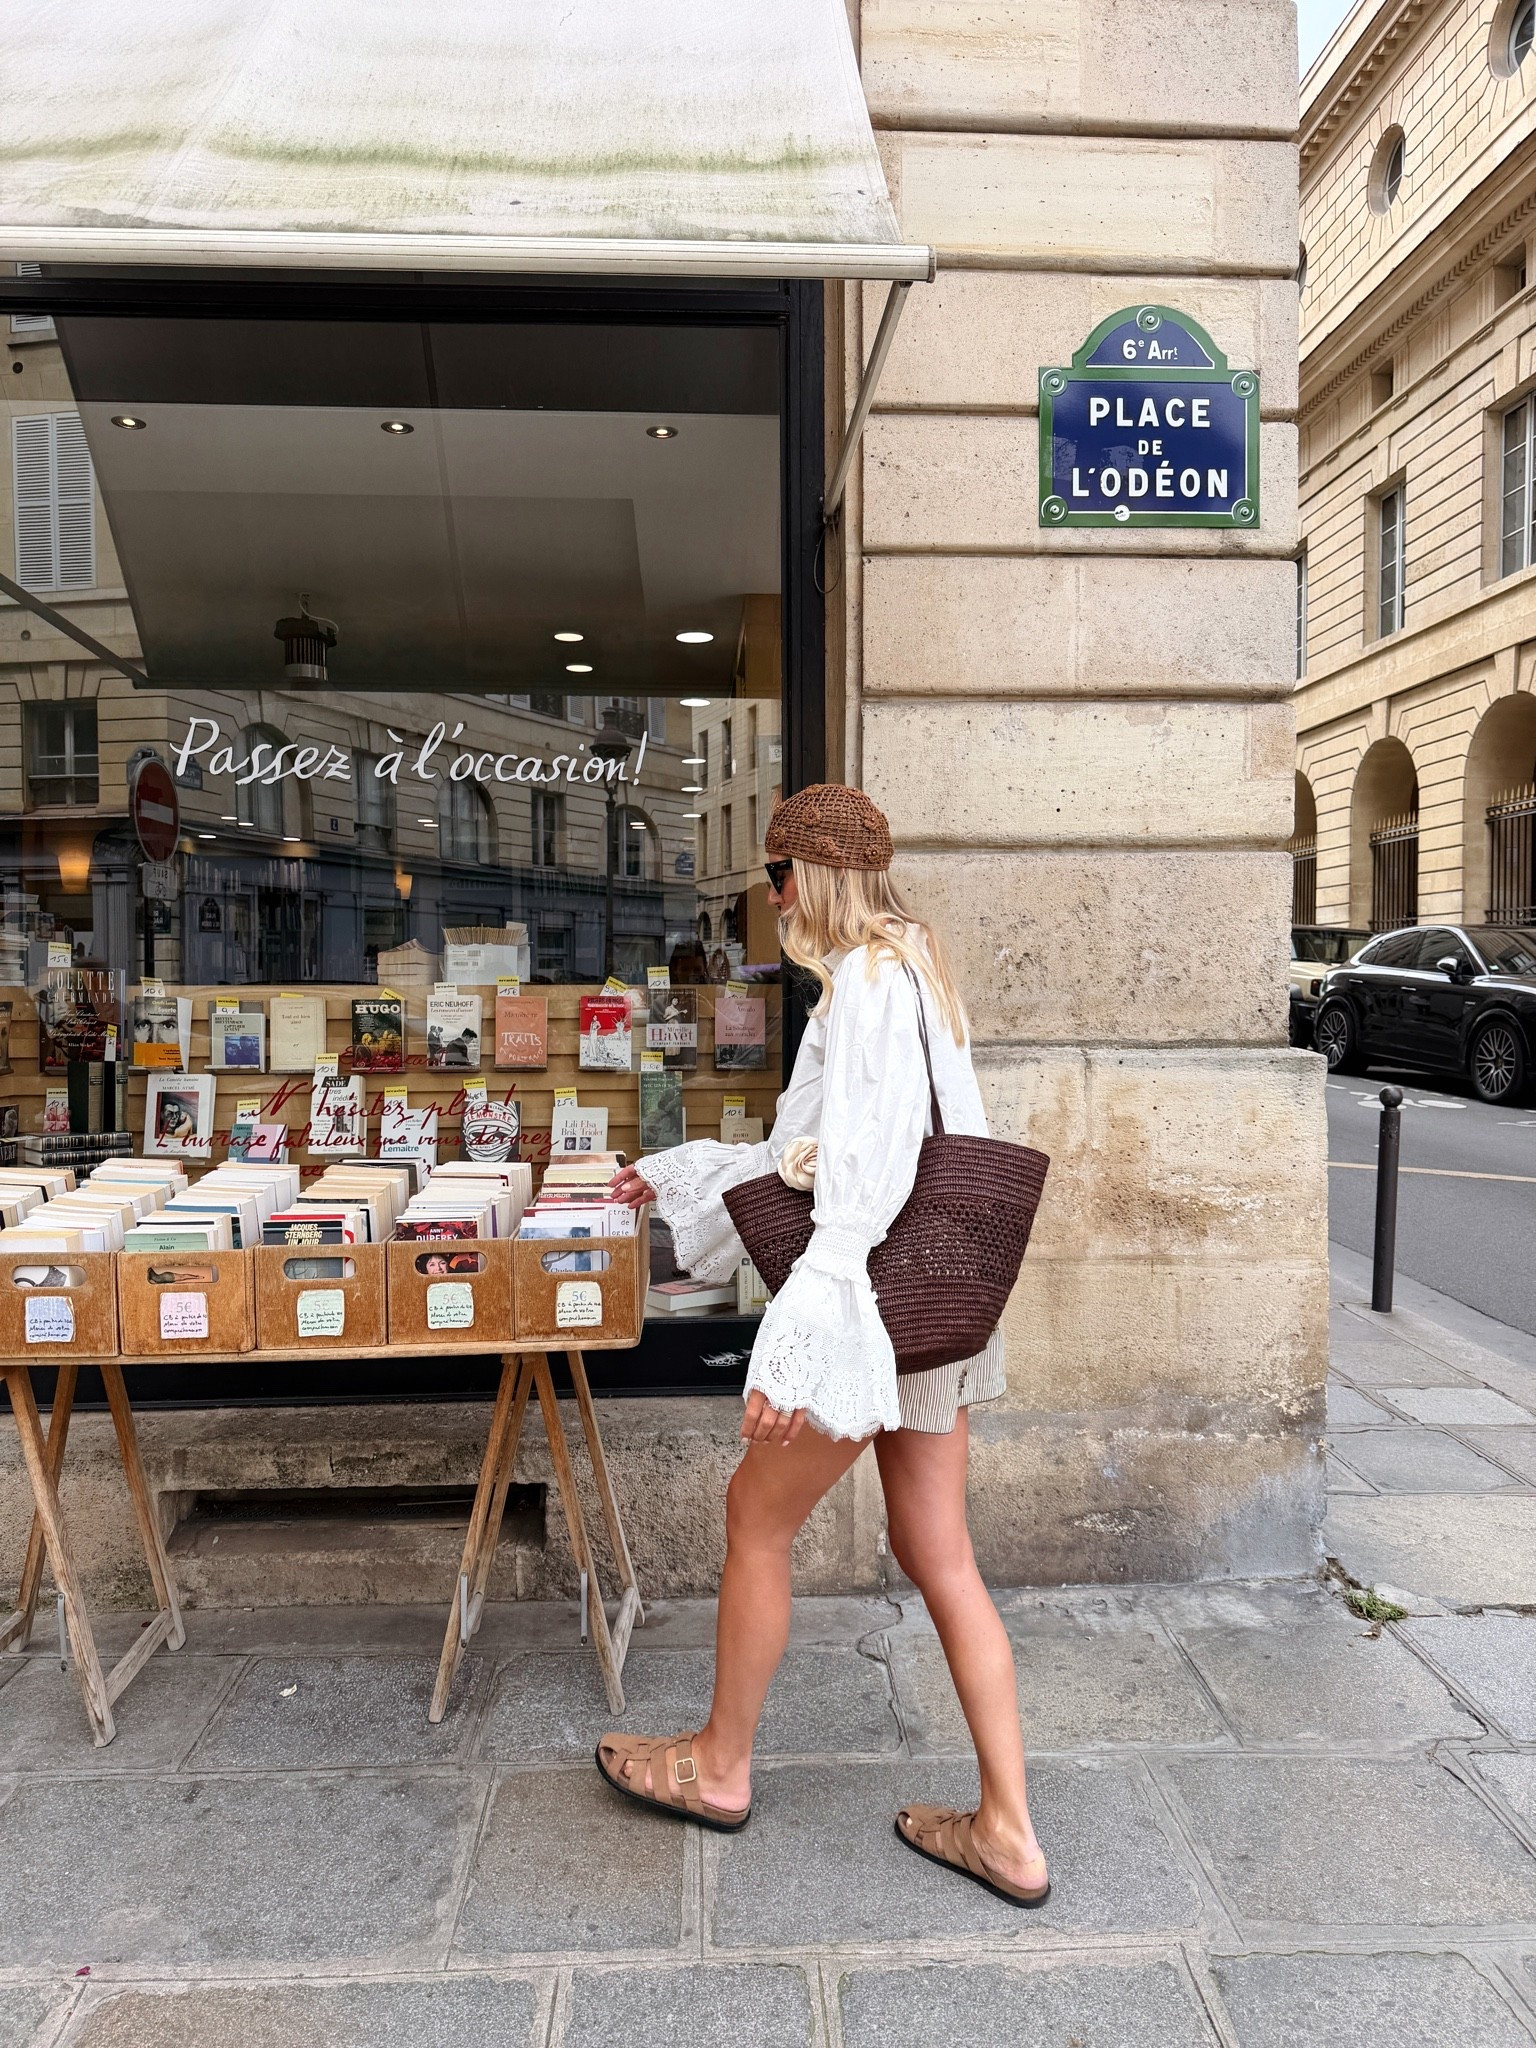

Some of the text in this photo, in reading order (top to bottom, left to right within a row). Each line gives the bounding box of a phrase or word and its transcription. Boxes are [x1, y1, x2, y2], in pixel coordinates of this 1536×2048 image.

[1089, 397, 1211, 428] PLACE
[1138, 440, 1162, 455] DE
[1072, 460, 1228, 498] L'ODÉON
[169, 716, 352, 785] Passez
[375, 728, 403, 784] à
[47, 971, 115, 991] COLETTE
[355, 1004, 401, 1014] HUGO
[502, 1031, 542, 1047] TRAITS
[651, 1028, 692, 1041] Havet
[316, 1065, 336, 1073] 10€
[325, 1080, 347, 1088] SADE
[565, 1119, 597, 1128] Lili Elsa
[561, 1128, 603, 1136] Brik Triolet
[268, 1121, 366, 1161] fabuleux
[289, 1223, 319, 1231] JACQUES
[442, 1293, 458, 1305] 5€
[571, 1290, 587, 1302] 5€
[176, 1301, 193, 1313] 5€
[313, 1300, 330, 1311] 5€
